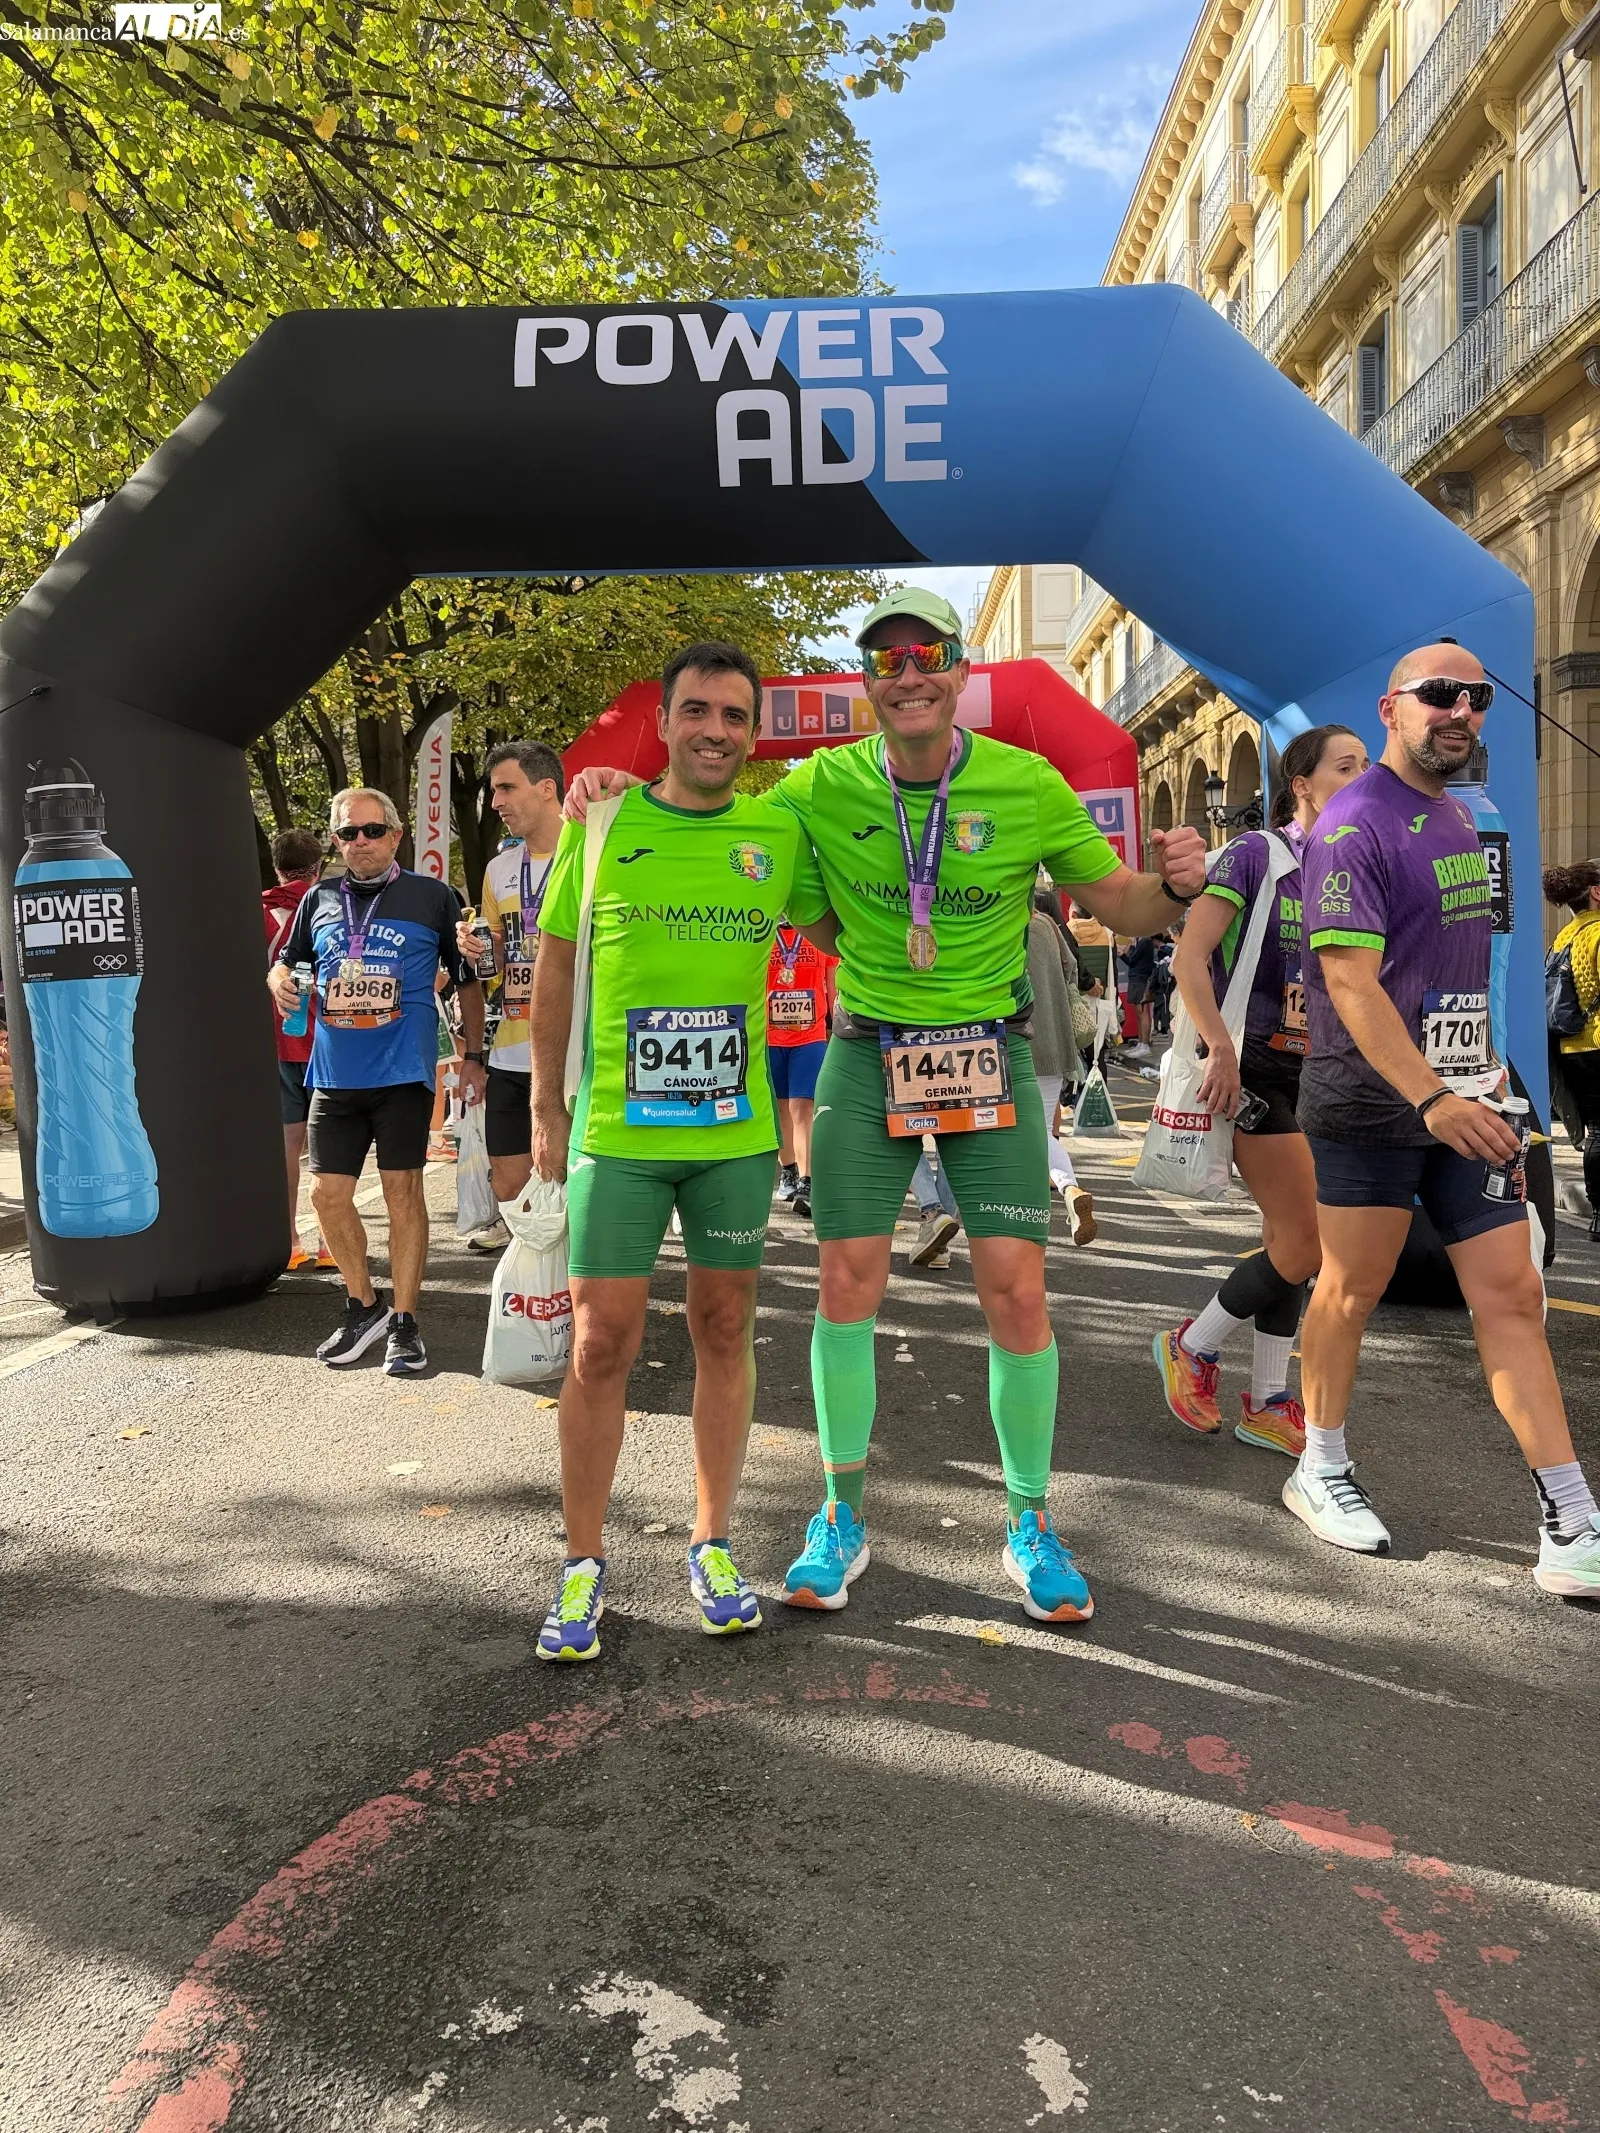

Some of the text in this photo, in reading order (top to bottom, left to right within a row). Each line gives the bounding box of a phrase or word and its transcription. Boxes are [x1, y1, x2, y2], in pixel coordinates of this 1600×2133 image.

[513, 307, 949, 388] POWER
[715, 384, 949, 488] ADE
[777, 711, 868, 730] URBI
[427, 735, 443, 844] VEOLIA
[1322, 870, 1351, 894] 60
[1459, 885, 1492, 907] SEBASTI
[21, 893, 125, 924] POWER
[616, 904, 765, 926] SANMAXIMO
[882, 900, 973, 916] TELCOM
[63, 918, 126, 945] ADE
[325, 924, 406, 947] ATTICO
[664, 924, 754, 943] TELECOM
[364, 963, 391, 975] ma
[332, 980, 393, 1000] 13968
[347, 1000, 372, 1008] JAVIER
[773, 1002, 812, 1013] 12074
[639, 1034, 740, 1072] 9414
[895, 1047, 998, 1083] 14476
[663, 1076, 718, 1088] CÁNOVAS
[924, 1084, 972, 1098] GERMÁN
[907, 1118, 936, 1129] Kaiku
[44, 1170, 145, 1188] POWERADE
[979, 1202, 1050, 1217] SANMAXIMO
[1003, 1211, 1047, 1224] TELECOM
[531, 1294, 572, 1317] EROS
[1169, 1331, 1179, 1362] HOKA
